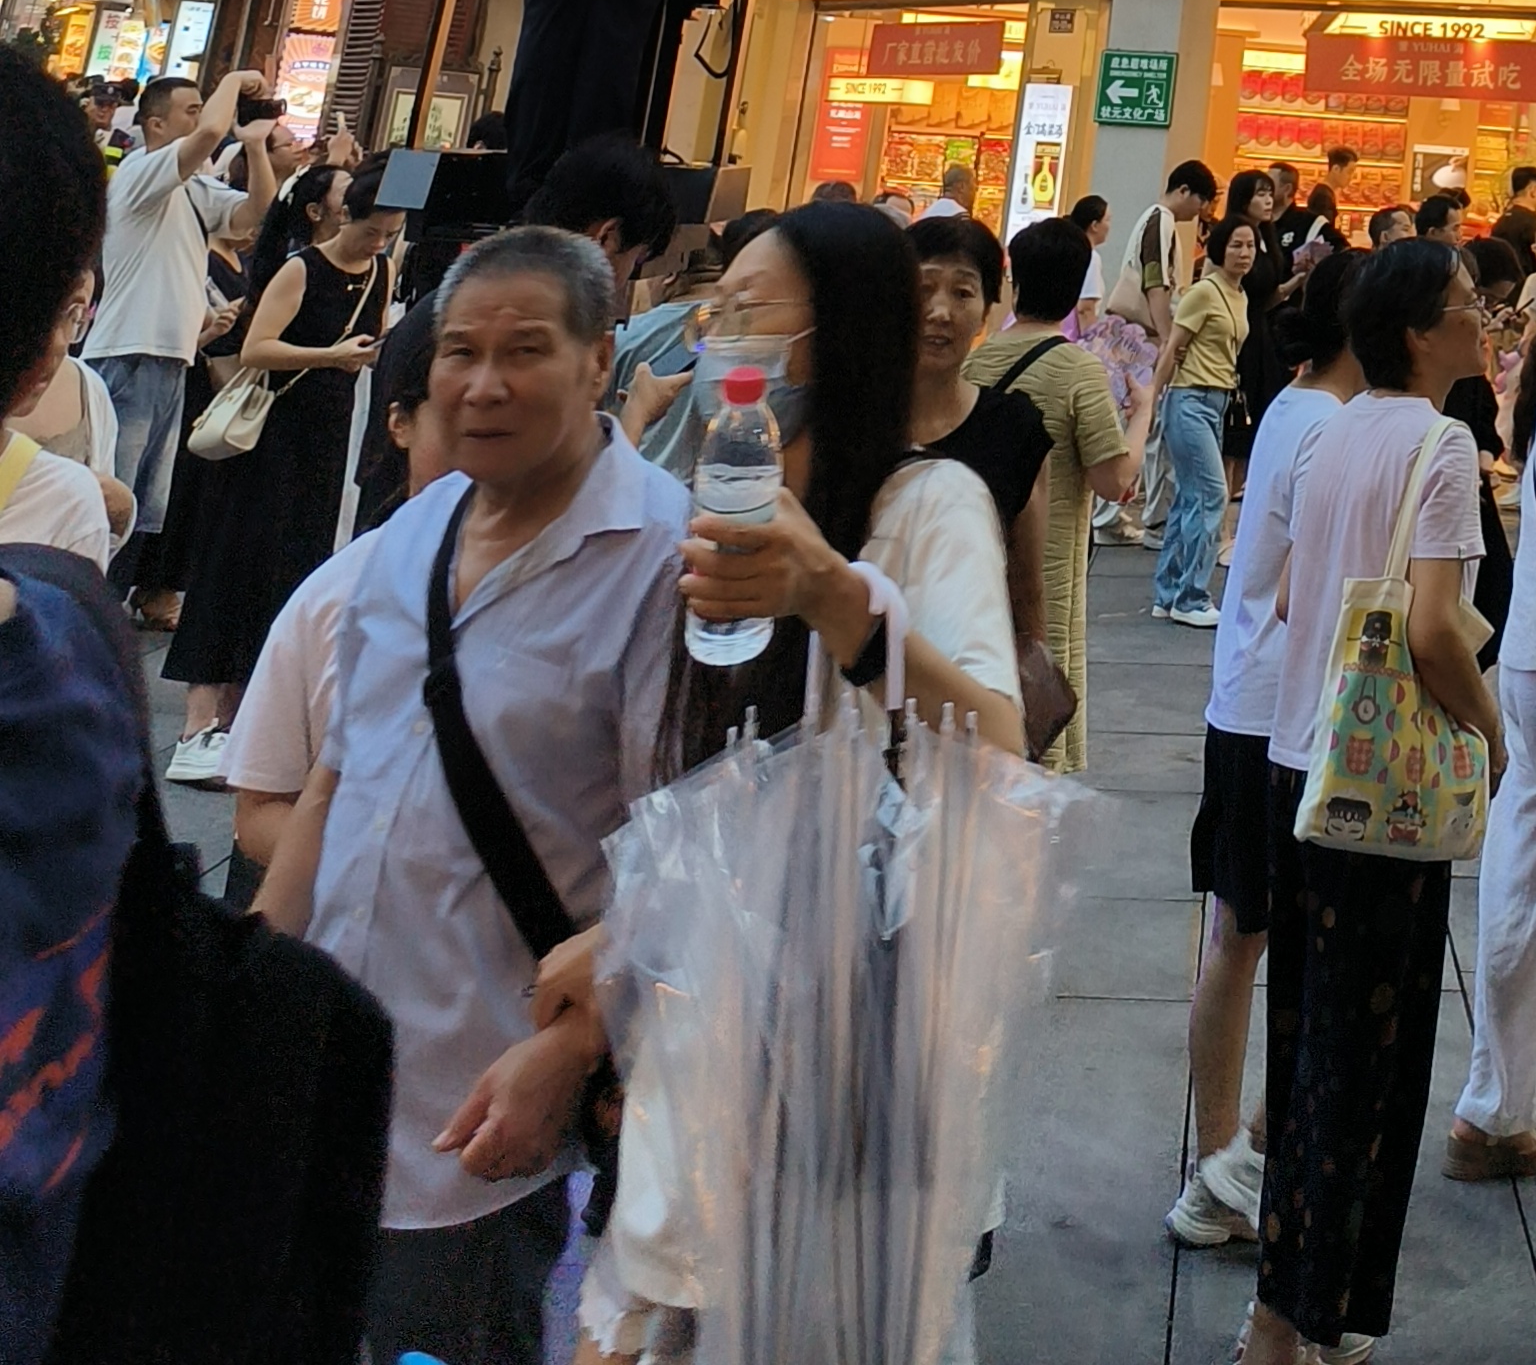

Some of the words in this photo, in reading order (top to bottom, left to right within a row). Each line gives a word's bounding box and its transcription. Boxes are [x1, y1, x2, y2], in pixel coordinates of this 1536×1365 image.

[1379, 20, 1433, 37] SINCE
[1440, 22, 1485, 38] 1992
[1339, 54, 1521, 90] 全场无限量试吃
[869, 82, 887, 94] 1992
[1100, 105, 1165, 121] 状元文化广场
